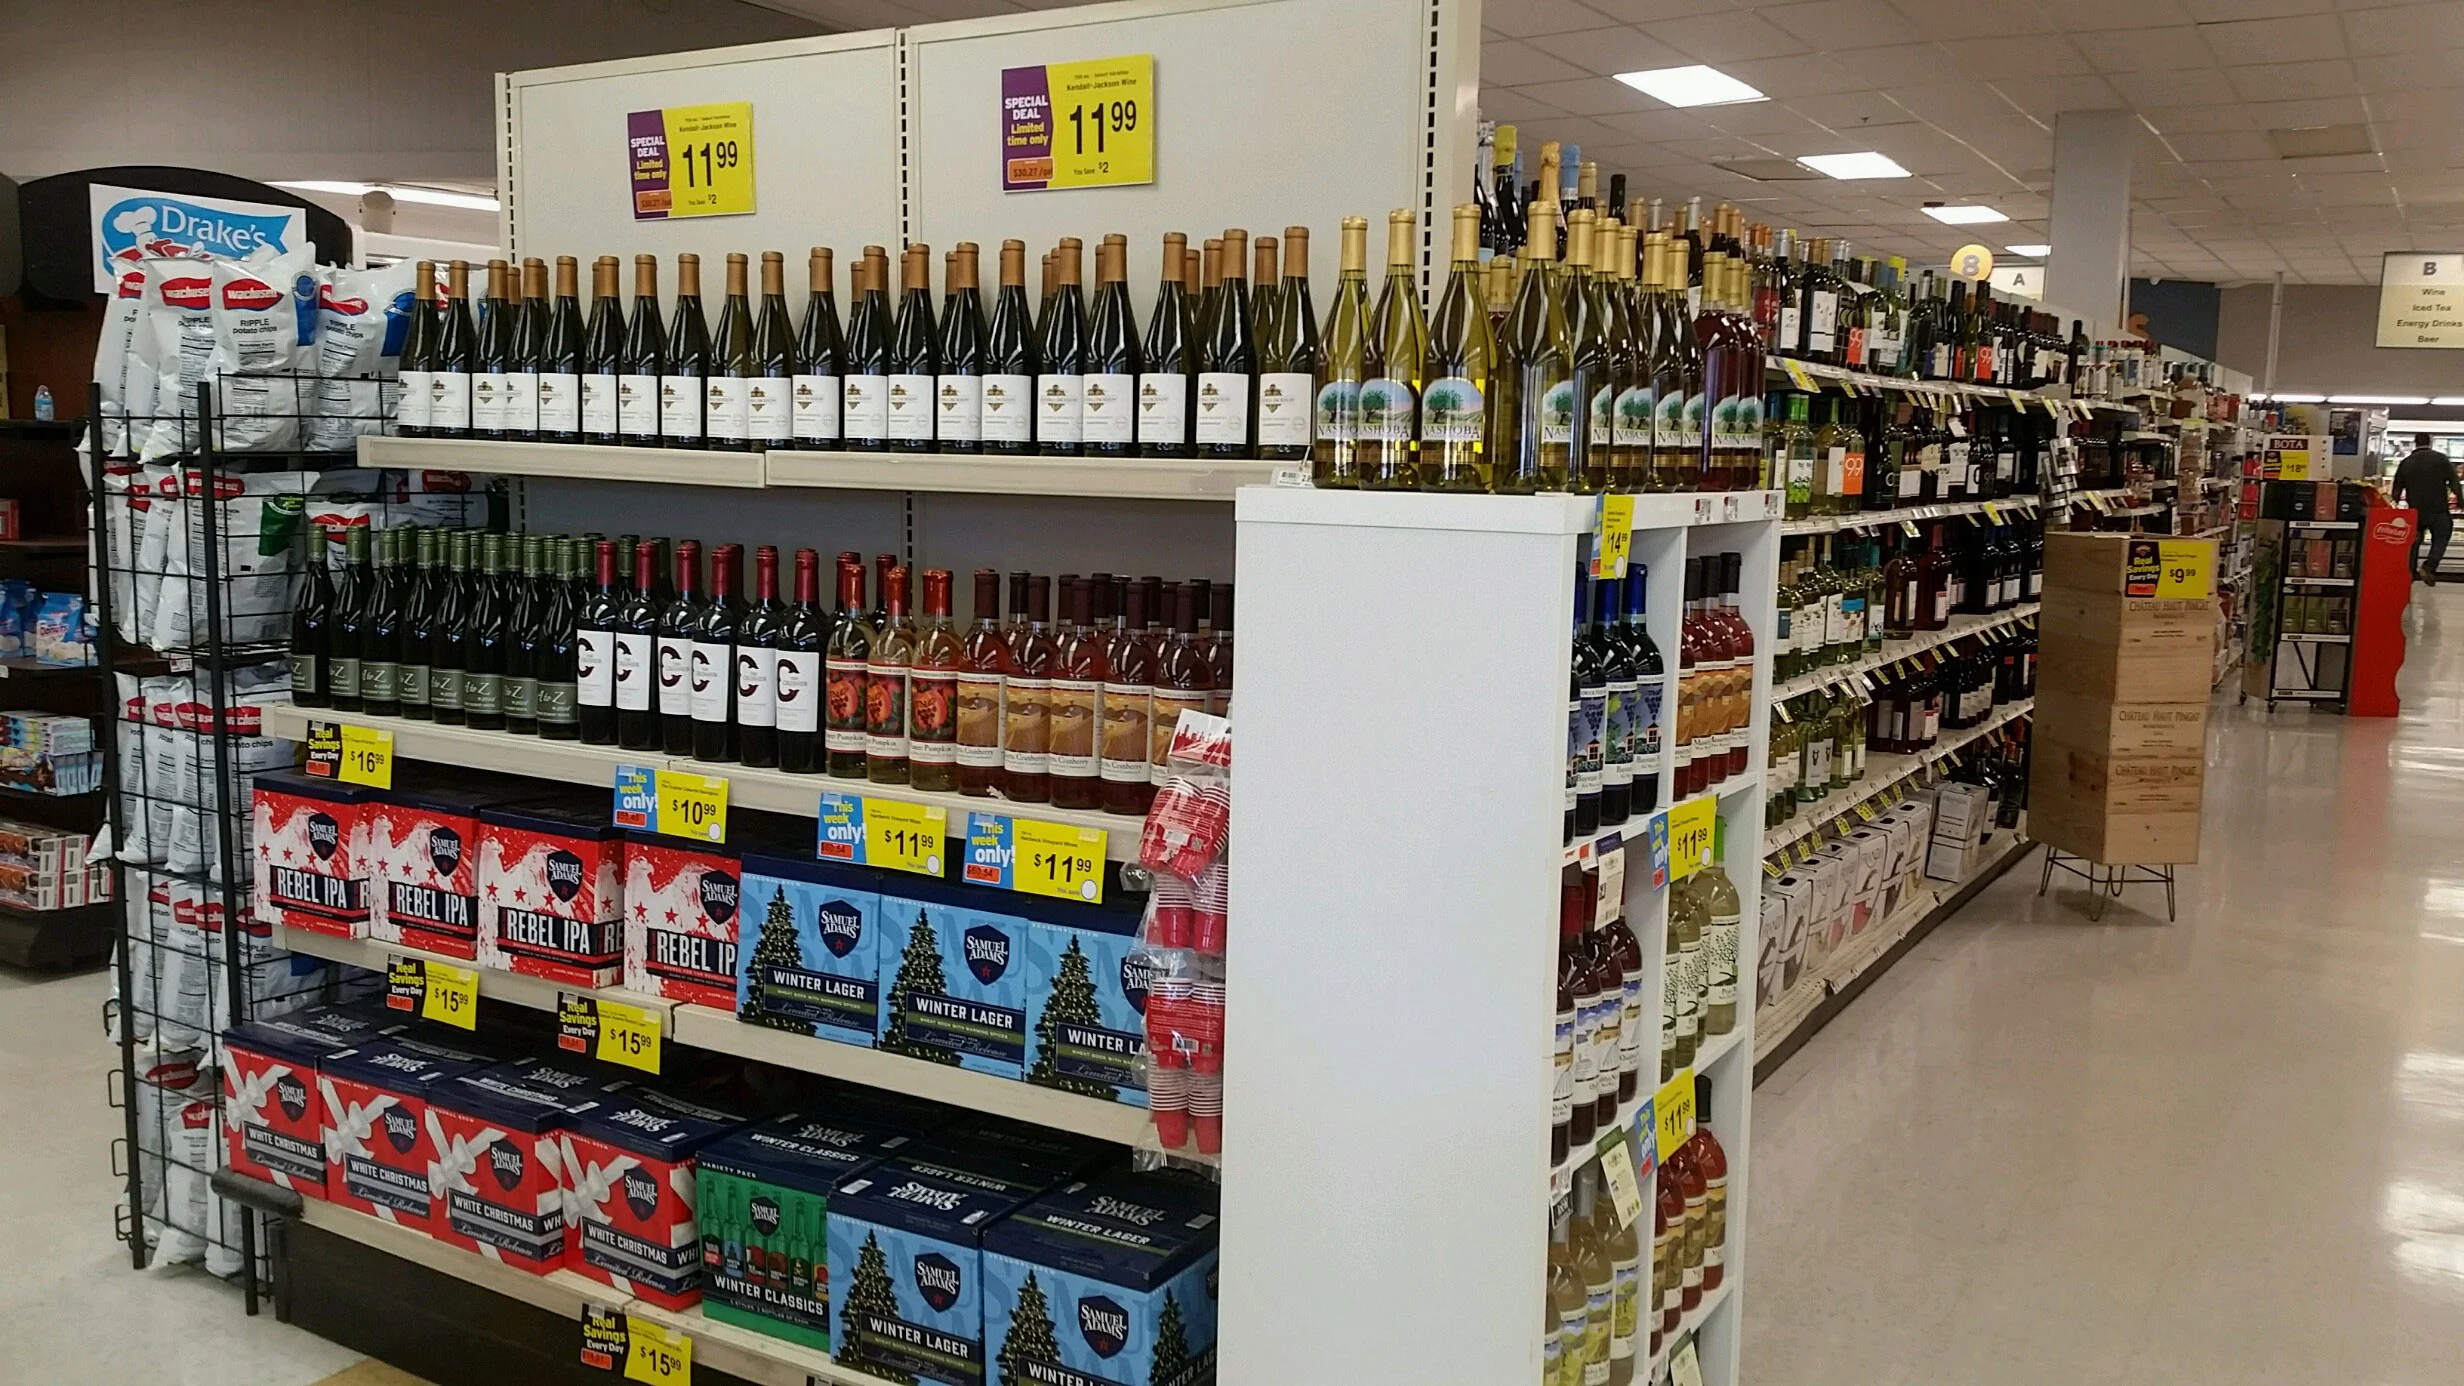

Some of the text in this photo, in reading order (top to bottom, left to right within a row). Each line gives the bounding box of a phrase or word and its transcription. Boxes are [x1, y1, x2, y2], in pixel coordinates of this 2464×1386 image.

[1121, 79, 1137, 87] Wine
[1004, 95, 1048, 110] SPECIAL
[1012, 107, 1041, 121] DEAL
[1011, 122, 1045, 134] Limited
[630, 136, 666, 148] SPECIAL
[1007, 134, 1049, 147] time only
[637, 147, 660, 157] DEAL
[161, 205, 267, 252] Drake's
[2423, 261, 2437, 276] B
[2013, 273, 2026, 286] A
[2396, 319, 2463, 329] Energy Drinks
[2417, 335, 2440, 343] Beer
[2273, 439, 2304, 449] BOTA
[2127, 565, 2160, 574] Savings
[2133, 557, 2153, 565] Real
[308, 738, 341, 752] Savings
[310, 751, 339, 761] Every Day
[619, 784, 643, 794] week
[823, 813, 849, 824] week
[309, 821, 338, 837] SAMUEL
[982, 822, 1004, 834] This
[311, 831, 337, 845] ADAMS
[431, 835, 460, 851] SAMUEL
[971, 834, 998, 846] week
[433, 845, 458, 860] ADAMS
[548, 859, 582, 876] SAMUEL
[551, 870, 579, 886] ADAMS
[278, 868, 321, 904] REBEL
[324, 877, 347, 909] IPA
[702, 880, 738, 897] SAMUEL
[397, 884, 441, 921] REBEL
[445, 894, 468, 926] IPA
[704, 891, 735, 907] ADAMS
[820, 910, 860, 929] SAMUEL
[507, 910, 559, 949] REBEL
[564, 921, 590, 955] IPA
[823, 922, 857, 939] ADAMS
[657, 931, 713, 972] REBEL
[966, 935, 1008, 955] SAMUEL
[969, 949, 1005, 966] ADAMS
[389, 972, 424, 987] Savings
[774, 970, 864, 1000] WINTER LAGER
[391, 985, 423, 997] Every Day
[567, 1002, 587, 1013] Real
[916, 997, 1013, 1029] WINTER LAGER
[560, 1011, 597, 1027] Savings
[563, 1025, 596, 1038] Every Day
[1067, 1028, 1123, 1052] WINTER
[278, 1082, 306, 1100] SAMUEL
[280, 1091, 304, 1108] ADAMS
[385, 1113, 416, 1132] SAMUEL
[388, 1123, 415, 1140] ADAMS
[248, 1127, 317, 1158] WHITE CHRISTMAS
[751, 1133, 860, 1162] WINTER CLASSICS
[491, 1147, 522, 1168] SAMUEL
[493, 1158, 520, 1176] ADAMS
[702, 1161, 757, 1178] VARIETY PACK
[351, 1160, 427, 1192] WHITE CHRISTMAS
[625, 1175, 657, 1195] SAMUEL
[628, 1186, 655, 1206] ADAMS
[454, 1194, 482, 1214] WHITE
[484, 1203, 533, 1232] CHRISTMAS
[751, 1202, 780, 1218] SAMUEL
[1084, 1206, 1149, 1226] ADAMS
[1092, 1196, 1168, 1221] SAMUEL
[753, 1211, 778, 1226] ADAMS
[1046, 1215, 1150, 1245] WINTER LAGER
[588, 1223, 616, 1245] WHITE
[618, 1235, 668, 1265] CHRISTMAS
[917, 1261, 959, 1285] SAMUEL
[921, 1275, 956, 1295] ADAMS
[714, 1274, 824, 1316] WINTER CLASSICS
[592, 1315, 615, 1329] Real
[1081, 1304, 1127, 1330] SAMUEL
[583, 1324, 626, 1344] Savings
[1084, 1318, 1124, 1340] ADAMS
[586, 1339, 625, 1355] Every Day
[870, 1318, 968, 1359] WINTER LAGER
